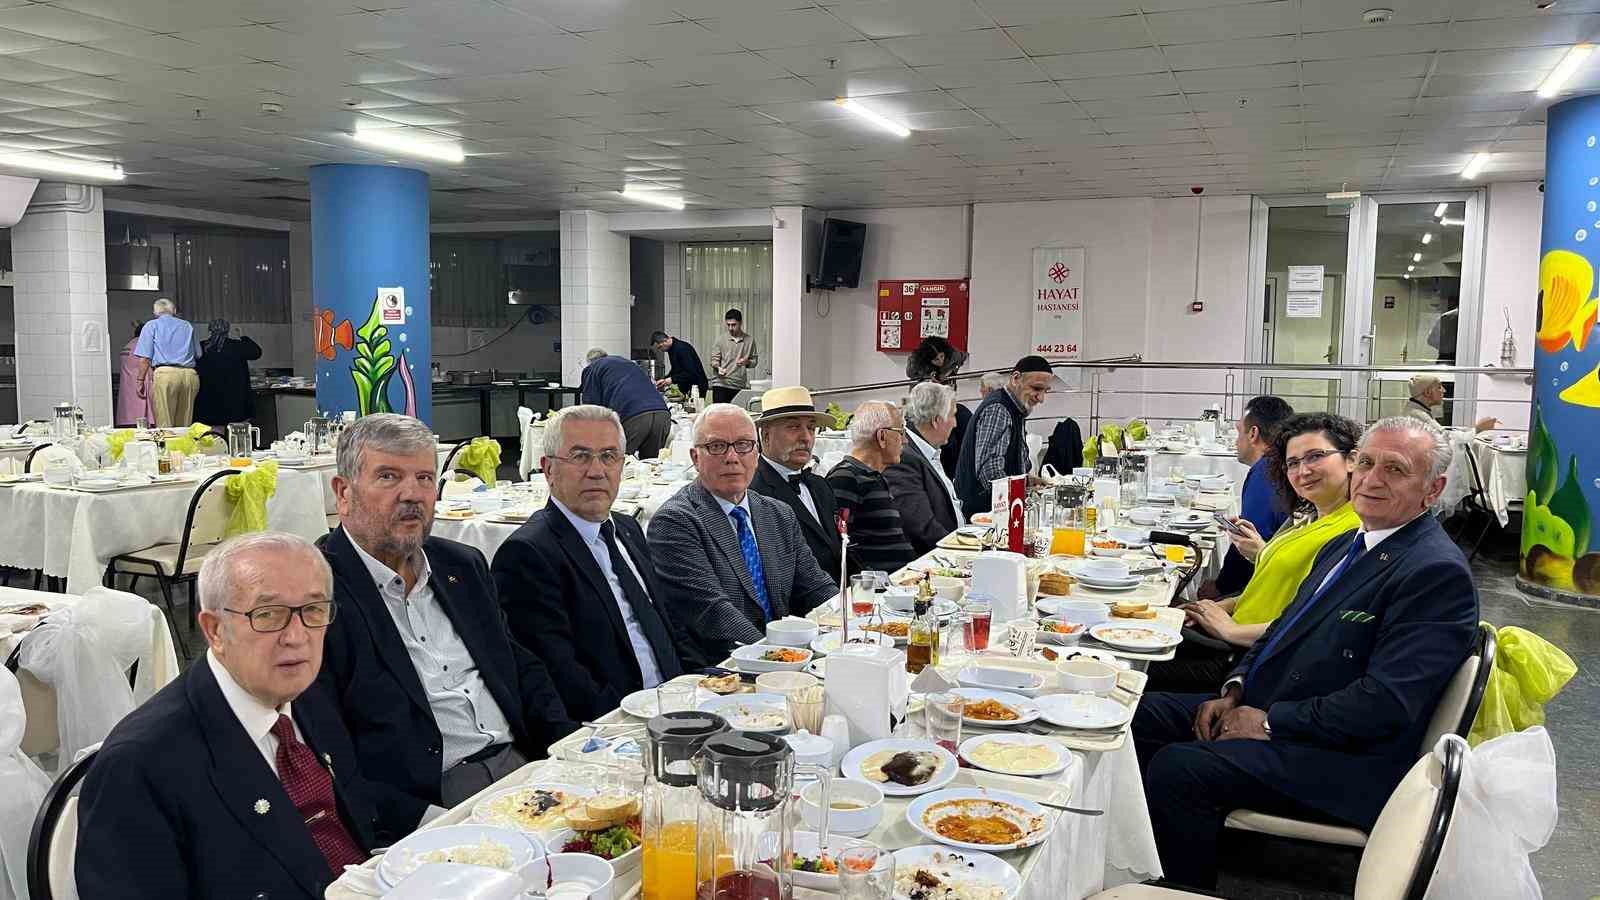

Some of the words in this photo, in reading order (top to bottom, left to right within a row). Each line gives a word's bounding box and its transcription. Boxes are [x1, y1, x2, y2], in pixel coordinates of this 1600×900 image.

[904, 285, 914, 293] 36
[1038, 288, 1079, 300] HAYAT
[1038, 302, 1079, 311] HASTANESİ
